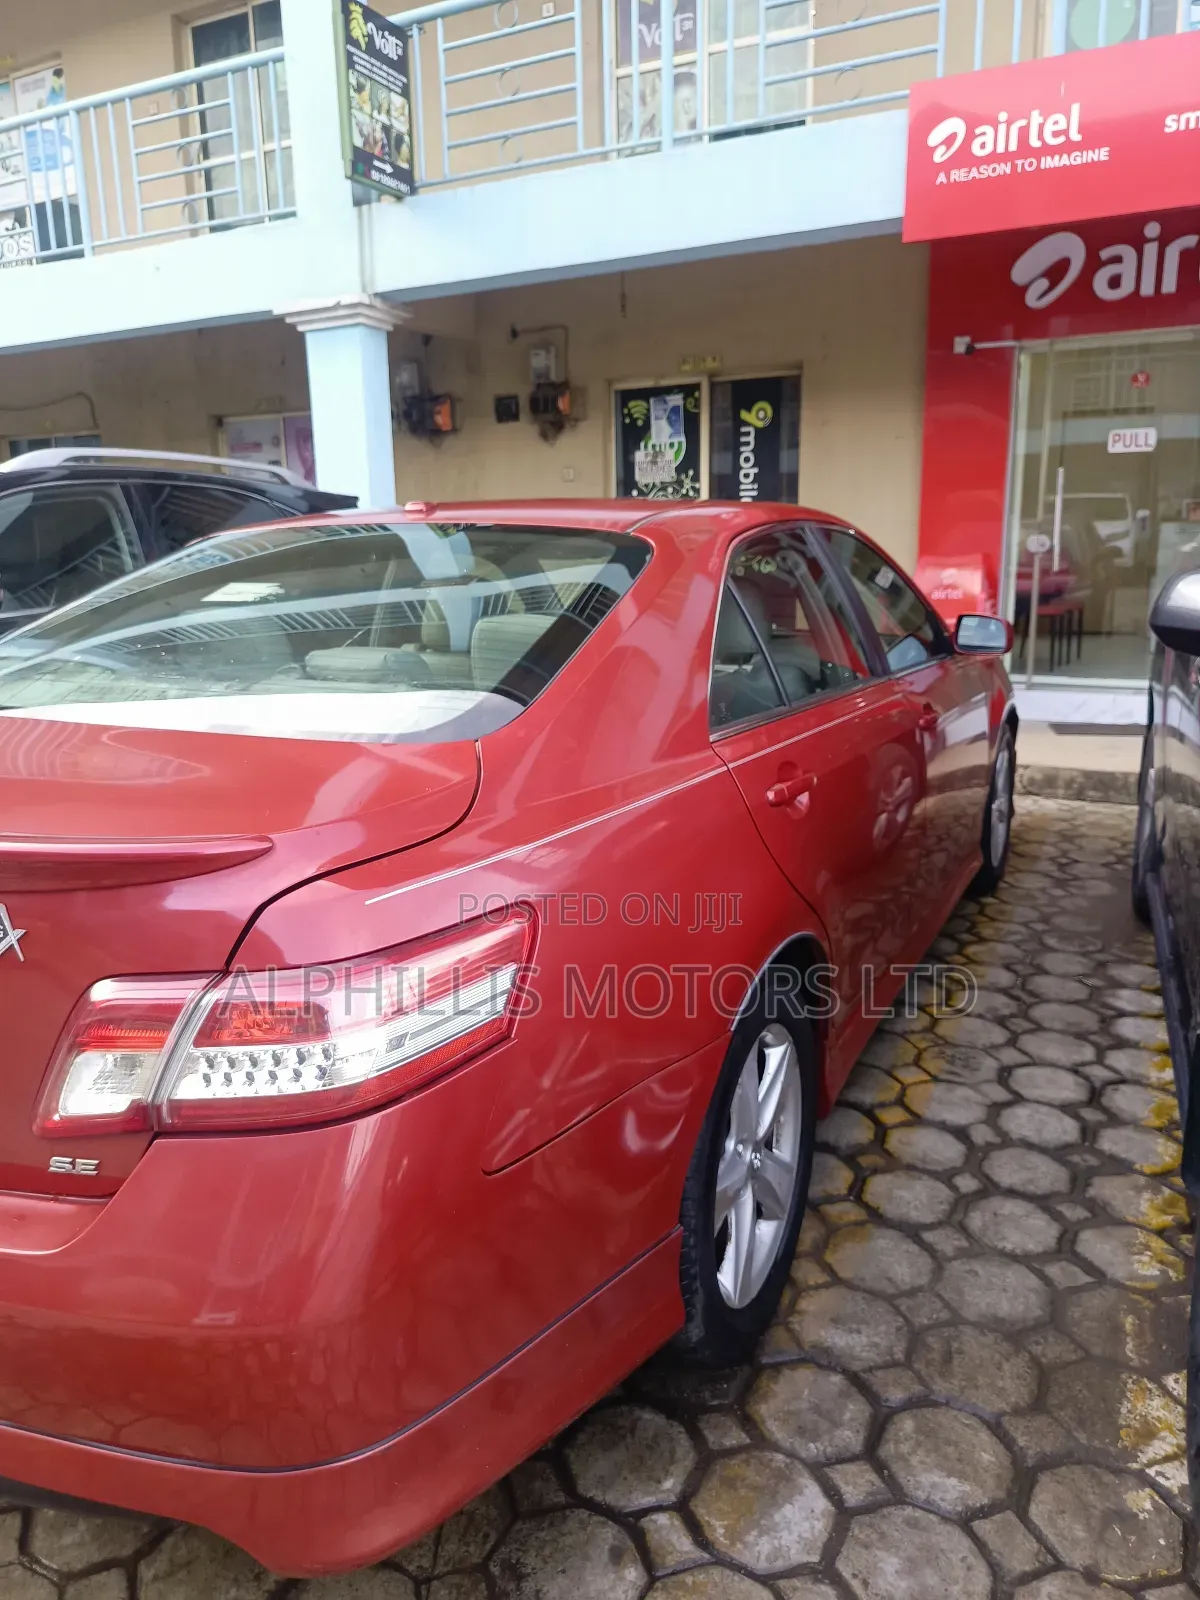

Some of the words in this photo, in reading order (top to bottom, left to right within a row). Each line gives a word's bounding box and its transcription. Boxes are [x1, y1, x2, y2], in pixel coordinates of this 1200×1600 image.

[971, 102, 1082, 157] airtel
[936, 171, 948, 186] A
[950, 161, 1011, 183] REASON
[1015, 157, 1037, 173] TO
[1040, 146, 1110, 171] IMAGINE
[1092, 220, 1200, 301] air
[1111, 432, 1153, 448] PULL
[48, 1156, 100, 1176] SE
